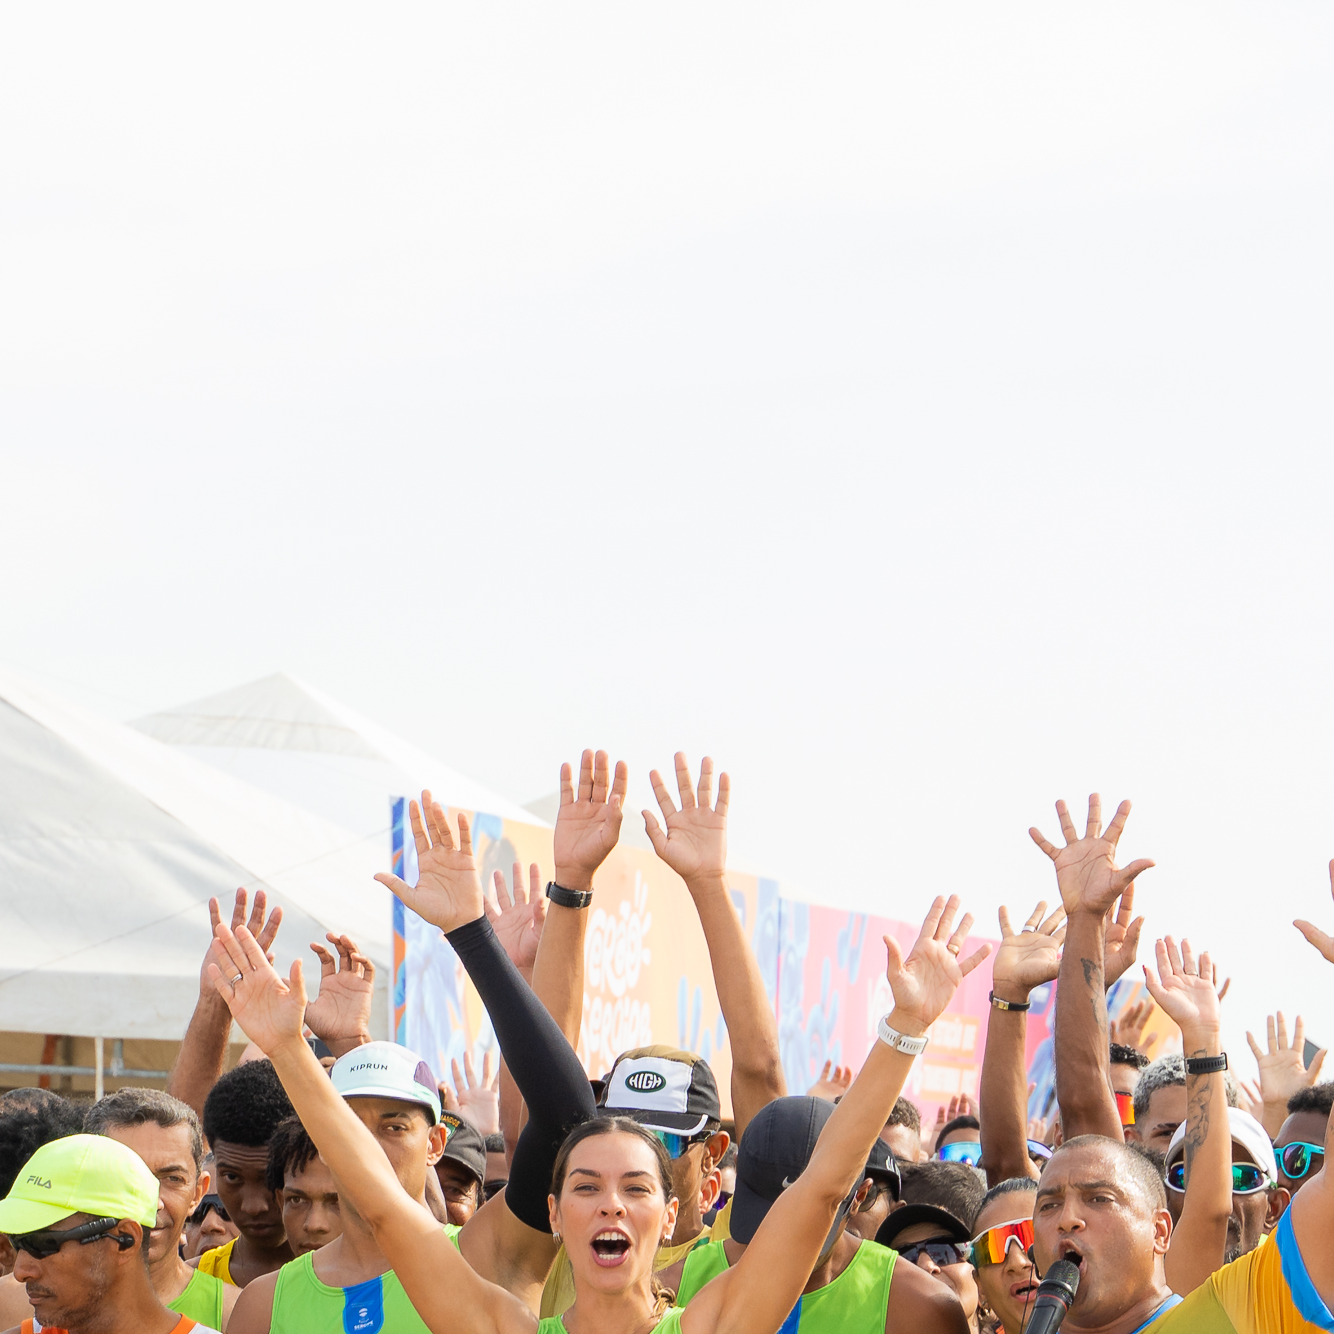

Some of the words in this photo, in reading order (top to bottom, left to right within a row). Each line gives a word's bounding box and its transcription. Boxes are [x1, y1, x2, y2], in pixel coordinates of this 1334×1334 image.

[349, 1063, 388, 1073] KIPRUN
[628, 1072, 664, 1090] HIGH
[26, 1175, 52, 1189] FILA
